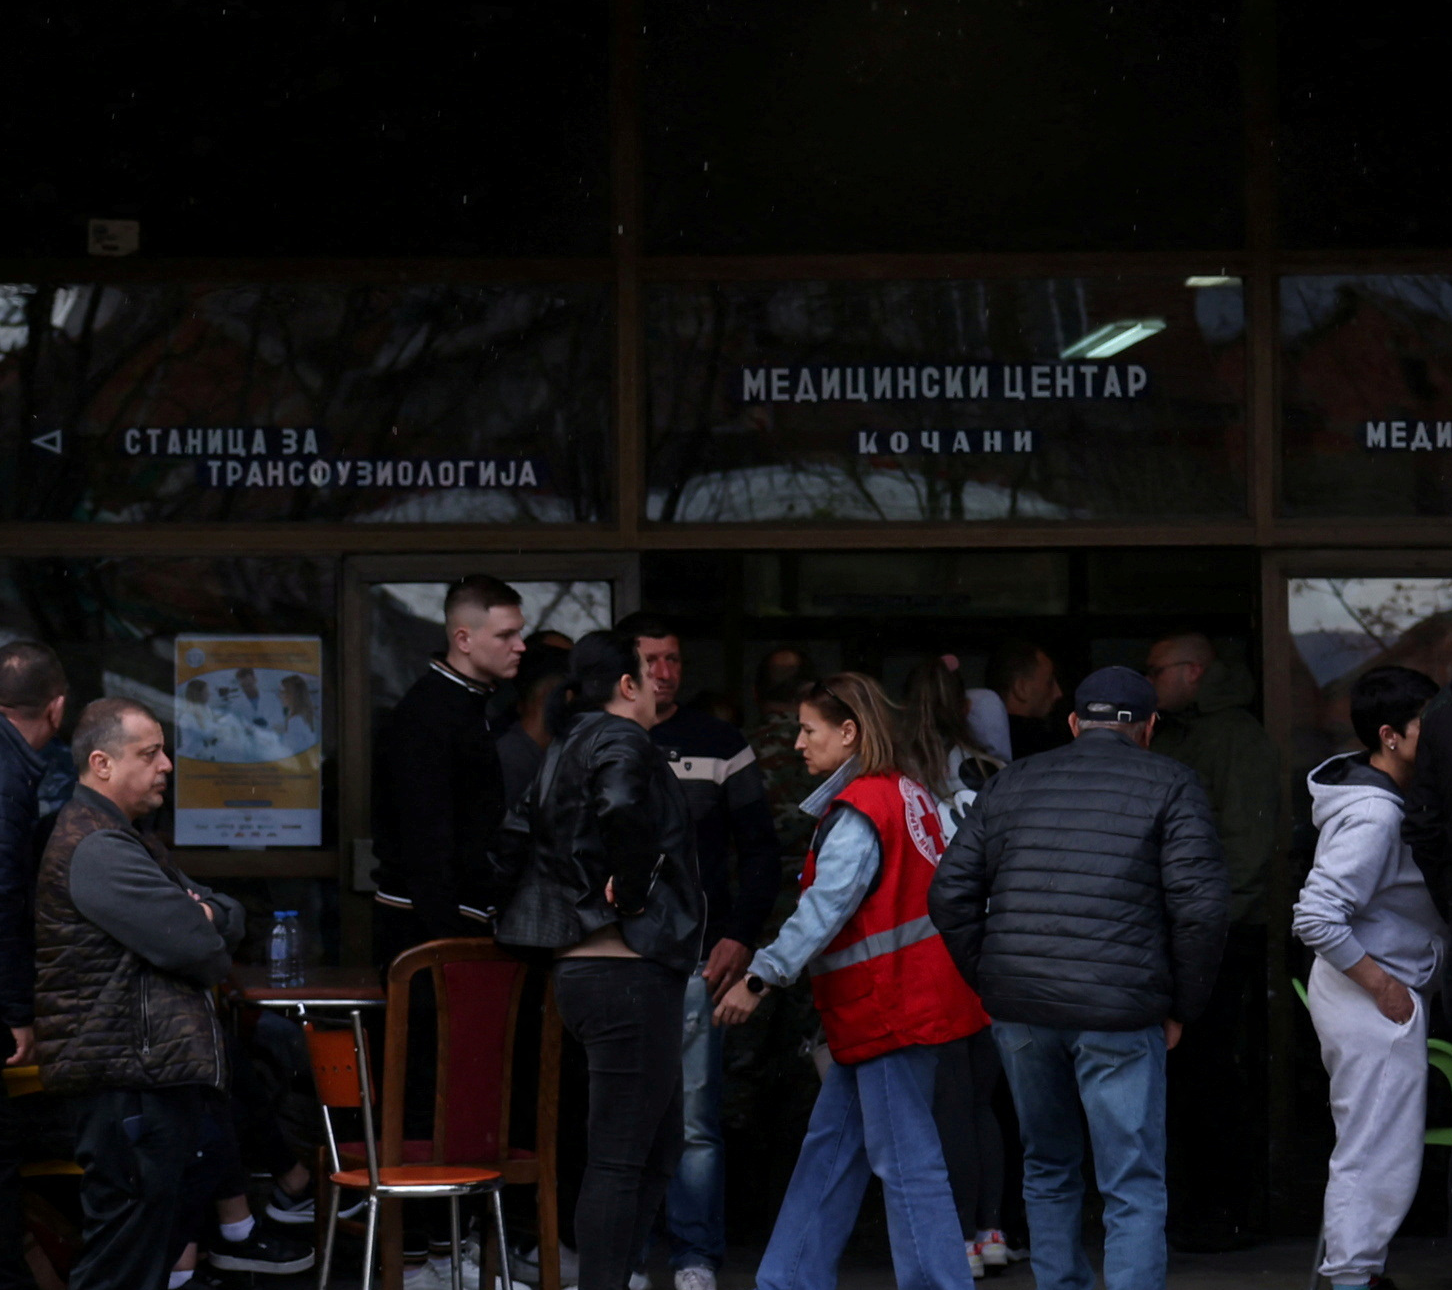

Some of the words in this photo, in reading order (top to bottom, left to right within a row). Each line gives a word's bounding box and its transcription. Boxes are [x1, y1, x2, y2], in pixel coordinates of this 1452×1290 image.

[744, 366, 988, 402] МЕДИЦИНСКИ
[1004, 365, 1147, 400] ЦЕНТАР
[125, 429, 265, 456] СТАНИЦА
[283, 430, 318, 453] ЗА
[859, 431, 1033, 453] КОЧАНИ
[208, 460, 537, 487] ТРАНСФУЗИОЛОГИЈА
